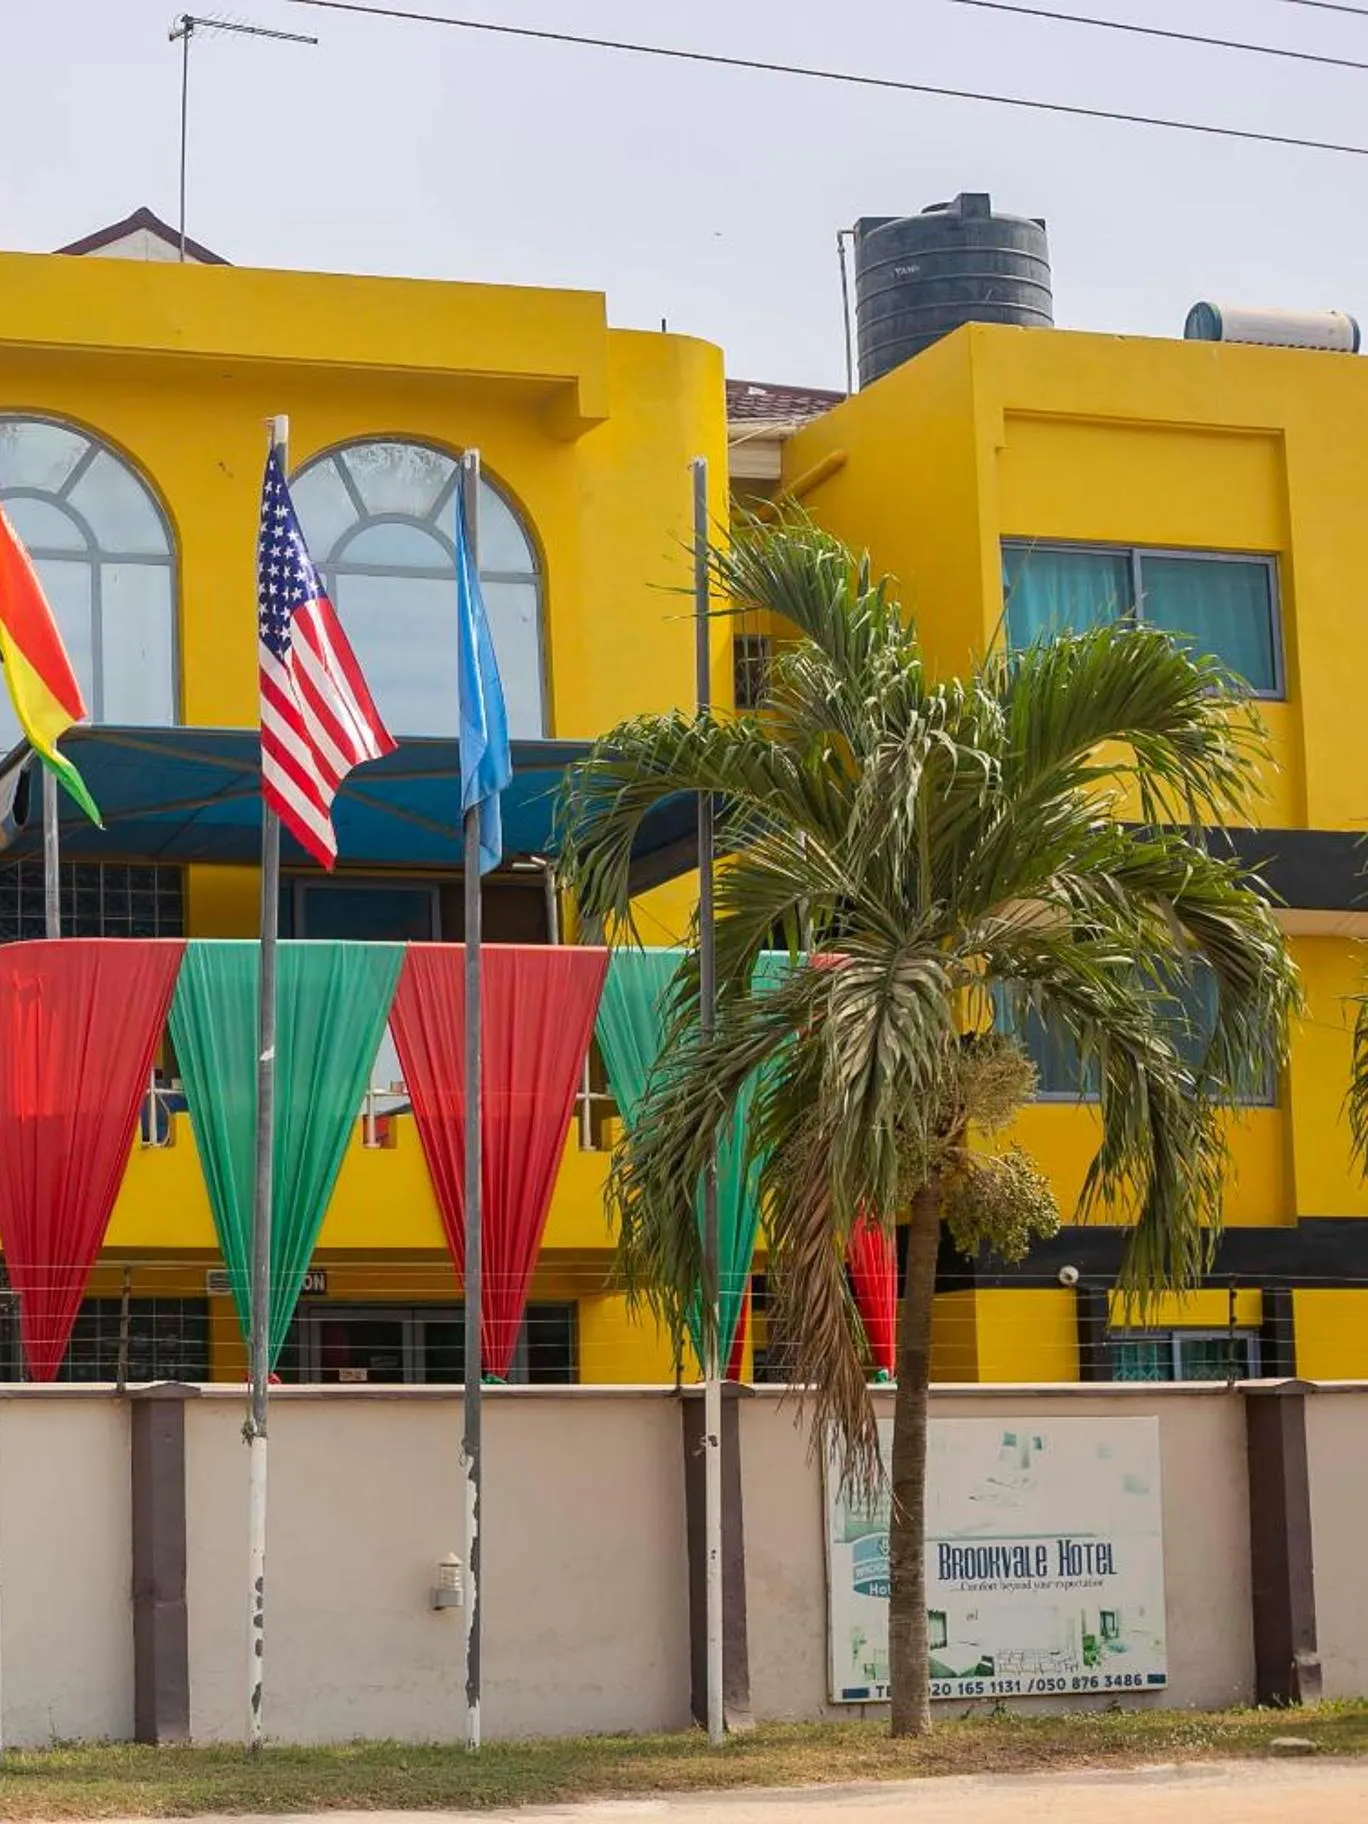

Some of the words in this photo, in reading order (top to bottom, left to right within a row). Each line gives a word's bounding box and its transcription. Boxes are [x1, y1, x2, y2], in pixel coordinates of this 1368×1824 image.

[928, 1683, 952, 1696] 20
[958, 1681, 984, 1695] 165
[990, 1679, 1020, 1693] 1131
[1072, 1675, 1099, 1690] 876
[1104, 1674, 1142, 1687] 3486
